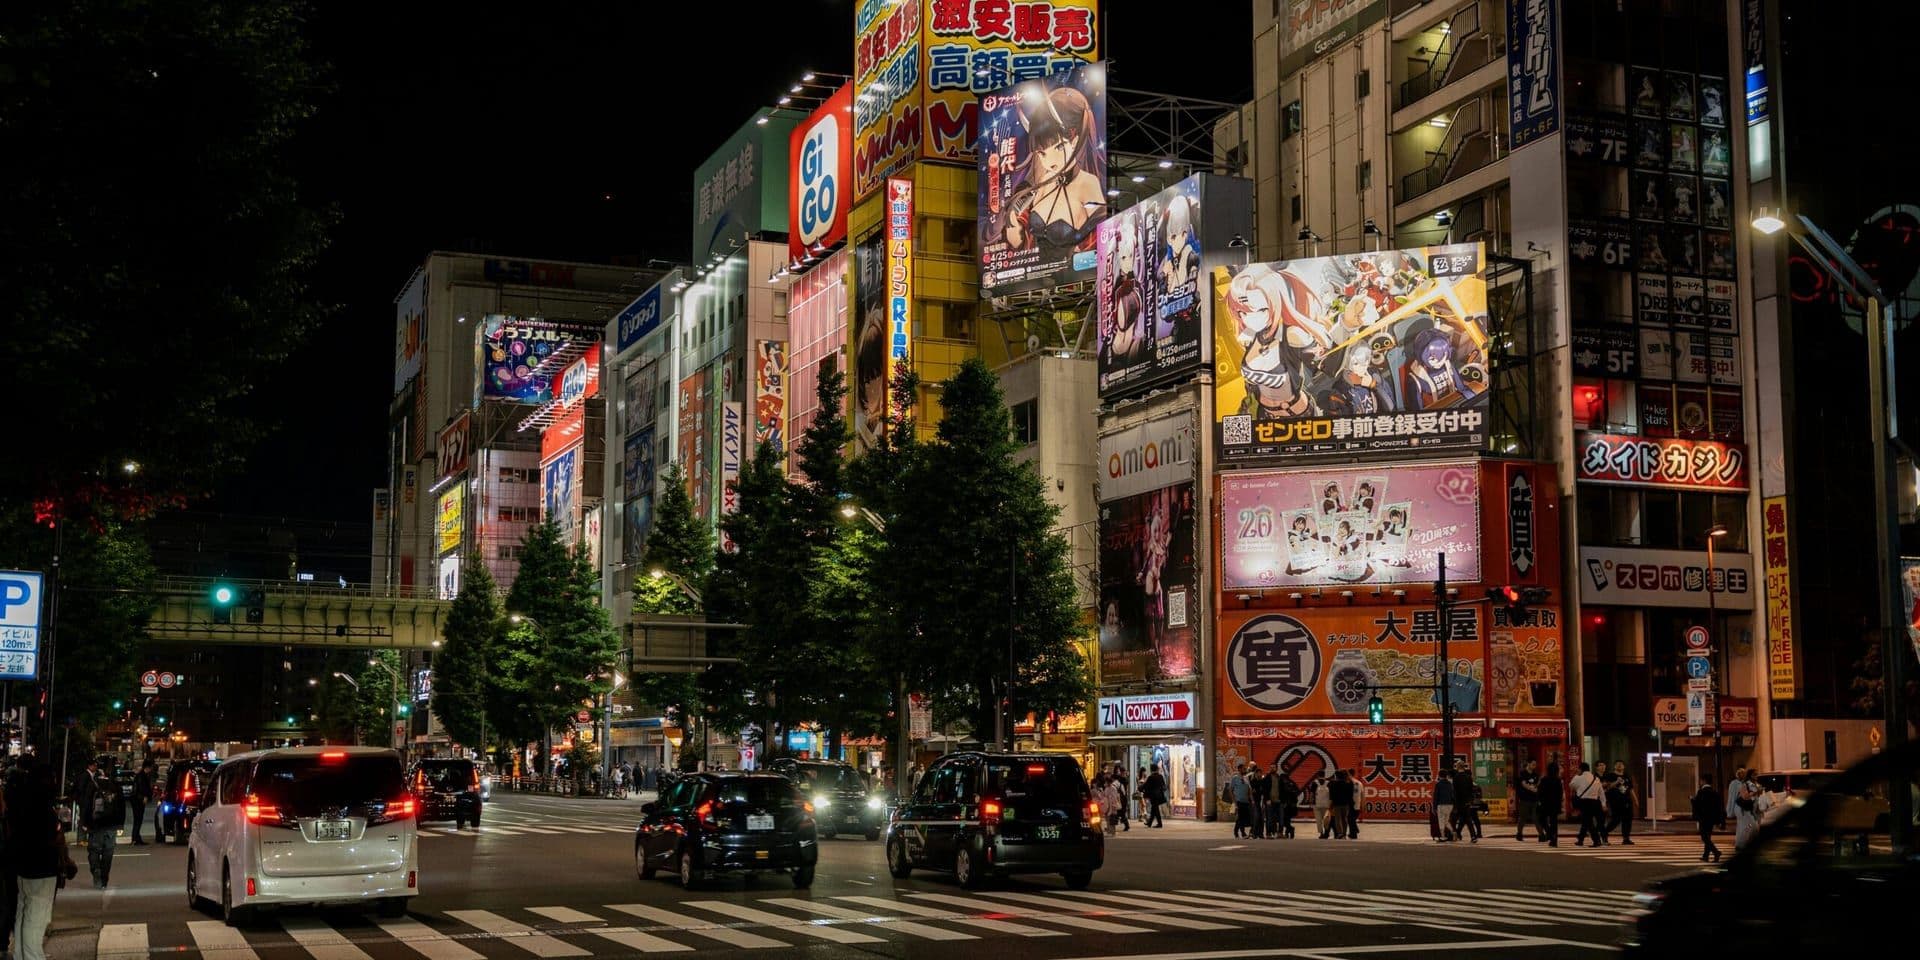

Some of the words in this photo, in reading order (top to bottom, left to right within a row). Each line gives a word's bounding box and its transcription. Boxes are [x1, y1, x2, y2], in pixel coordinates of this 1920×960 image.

[1600, 139, 1628, 162] 7F
[1602, 240, 1631, 265] 6F
[1607, 350, 1635, 373] 5F
[1584, 442, 1743, 483] メイドカジノ
[1618, 566, 1746, 592] スマホ修理王
[1779, 573, 1788, 610] TAX
[1327, 631, 1369, 645] チケット
[1374, 608, 1479, 643] 大黒屋
[1692, 633, 1703, 643] 40
[1781, 616, 1792, 664] FREE
[1238, 629, 1307, 700] 質
[1127, 703, 1158, 720] COMIC
[1160, 703, 1174, 719] ZIN
[1657, 712, 1687, 723] TOKIS
